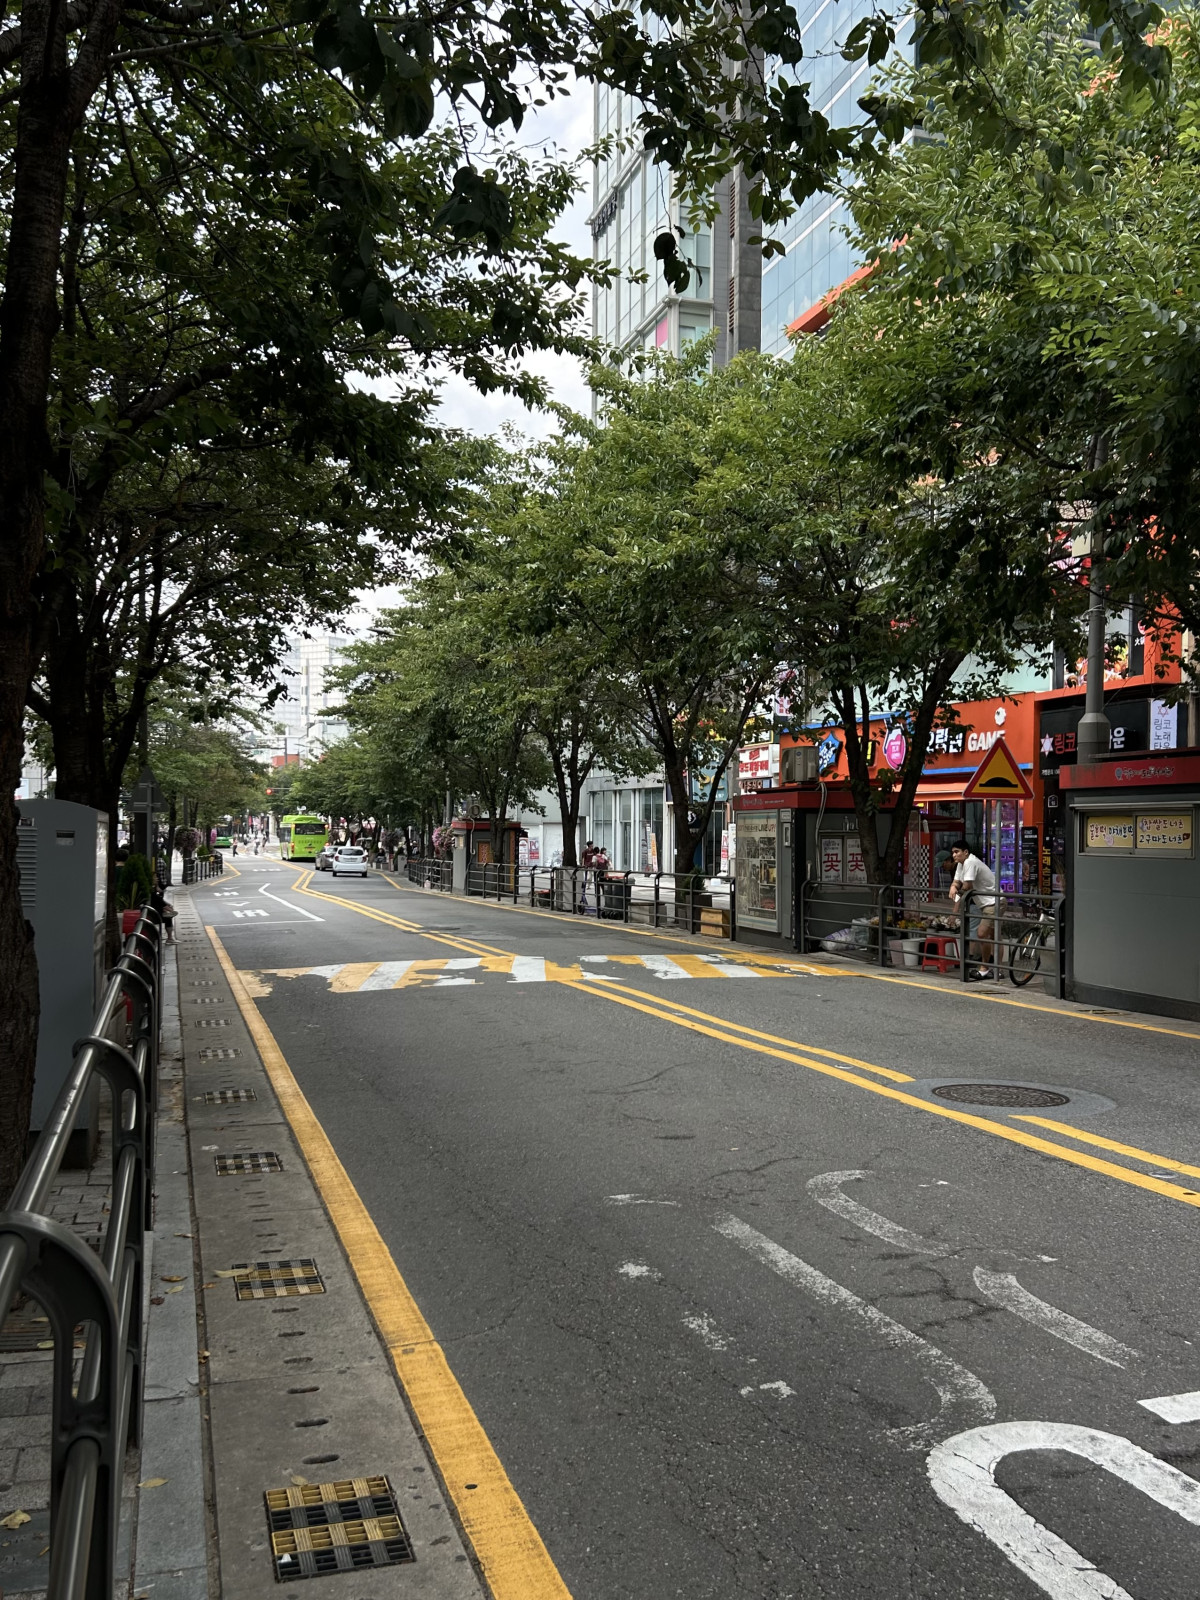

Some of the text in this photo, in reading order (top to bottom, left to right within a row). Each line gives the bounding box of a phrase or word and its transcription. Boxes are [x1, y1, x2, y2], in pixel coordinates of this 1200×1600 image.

[1154, 717, 1173, 730] 링코
[967, 729, 1006, 752] GAME
[1053, 731, 1076, 755] 링코
[1154, 731, 1172, 742] 노래
[823, 852, 842, 873] 꽃
[848, 852, 865, 873] 꽃
